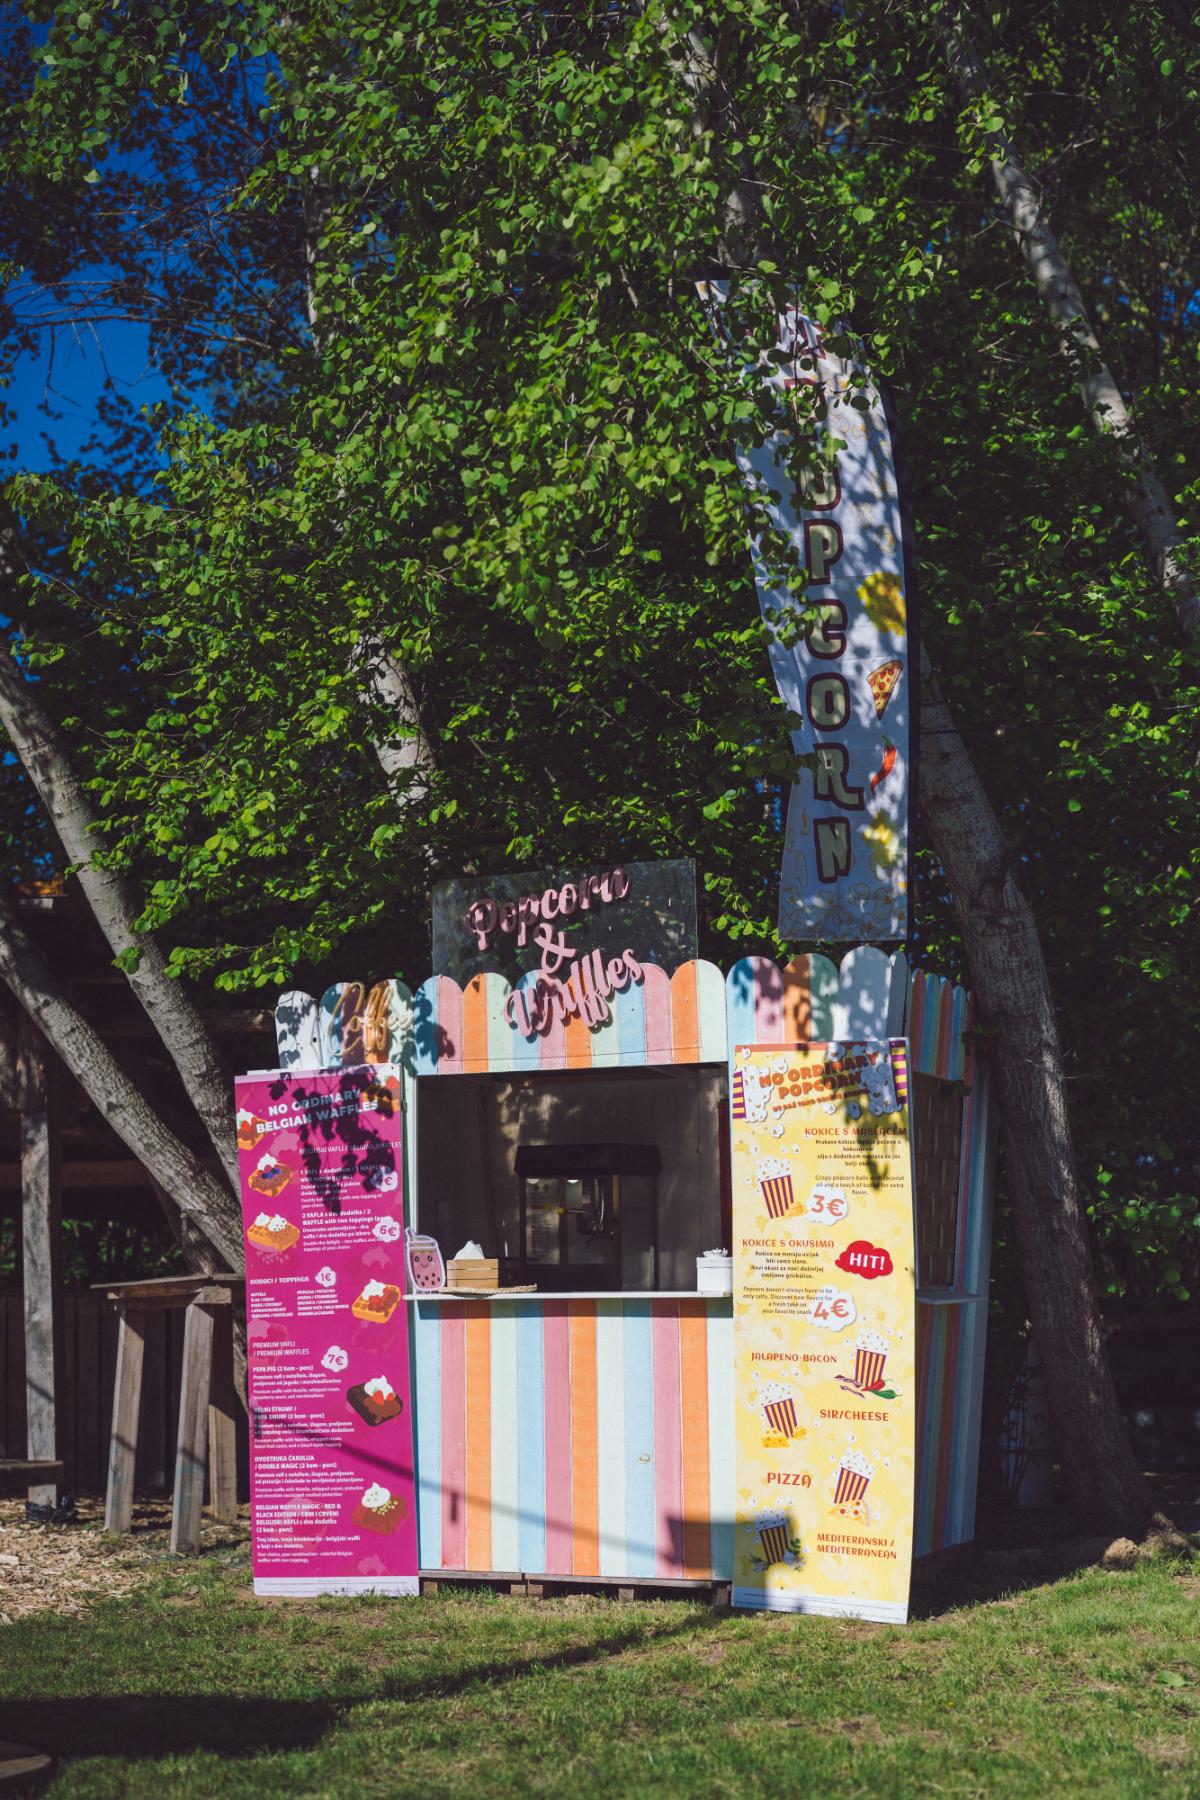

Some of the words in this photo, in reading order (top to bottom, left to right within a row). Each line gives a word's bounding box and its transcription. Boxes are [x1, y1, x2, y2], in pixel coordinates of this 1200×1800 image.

[465, 868, 632, 950] Popcorn
[533, 923, 577, 974] &
[504, 948, 645, 1038] Waffles
[759, 1072, 784, 1088] NO
[787, 1052, 877, 1082] ORDINARY
[778, 1071, 861, 1100] POPCORN
[268, 1104, 287, 1116] NO
[292, 1089, 361, 1111] ORDINARY
[256, 1114, 312, 1134] BELGIAN
[316, 1100, 379, 1121] WAFFLES
[811, 1194, 845, 1217] 3€
[380, 1225, 397, 1236] 6€
[742, 1239, 776, 1248] KOKICE
[780, 1239, 786, 1248] S
[789, 1239, 835, 1249] OKUSIMA
[849, 1252, 886, 1271] HIT!
[321, 1273, 332, 1281] 1€
[813, 1298, 849, 1320] 4€
[328, 1354, 344, 1365] 7€
[751, 1352, 837, 1363] JALAPENO-BACON
[819, 1409, 889, 1422] SIR/CHEESE
[767, 1472, 812, 1489] PIZZA
[817, 1533, 888, 1547] MEDITERANSKI
[816, 1544, 897, 1559] MEDITERRANEAN
